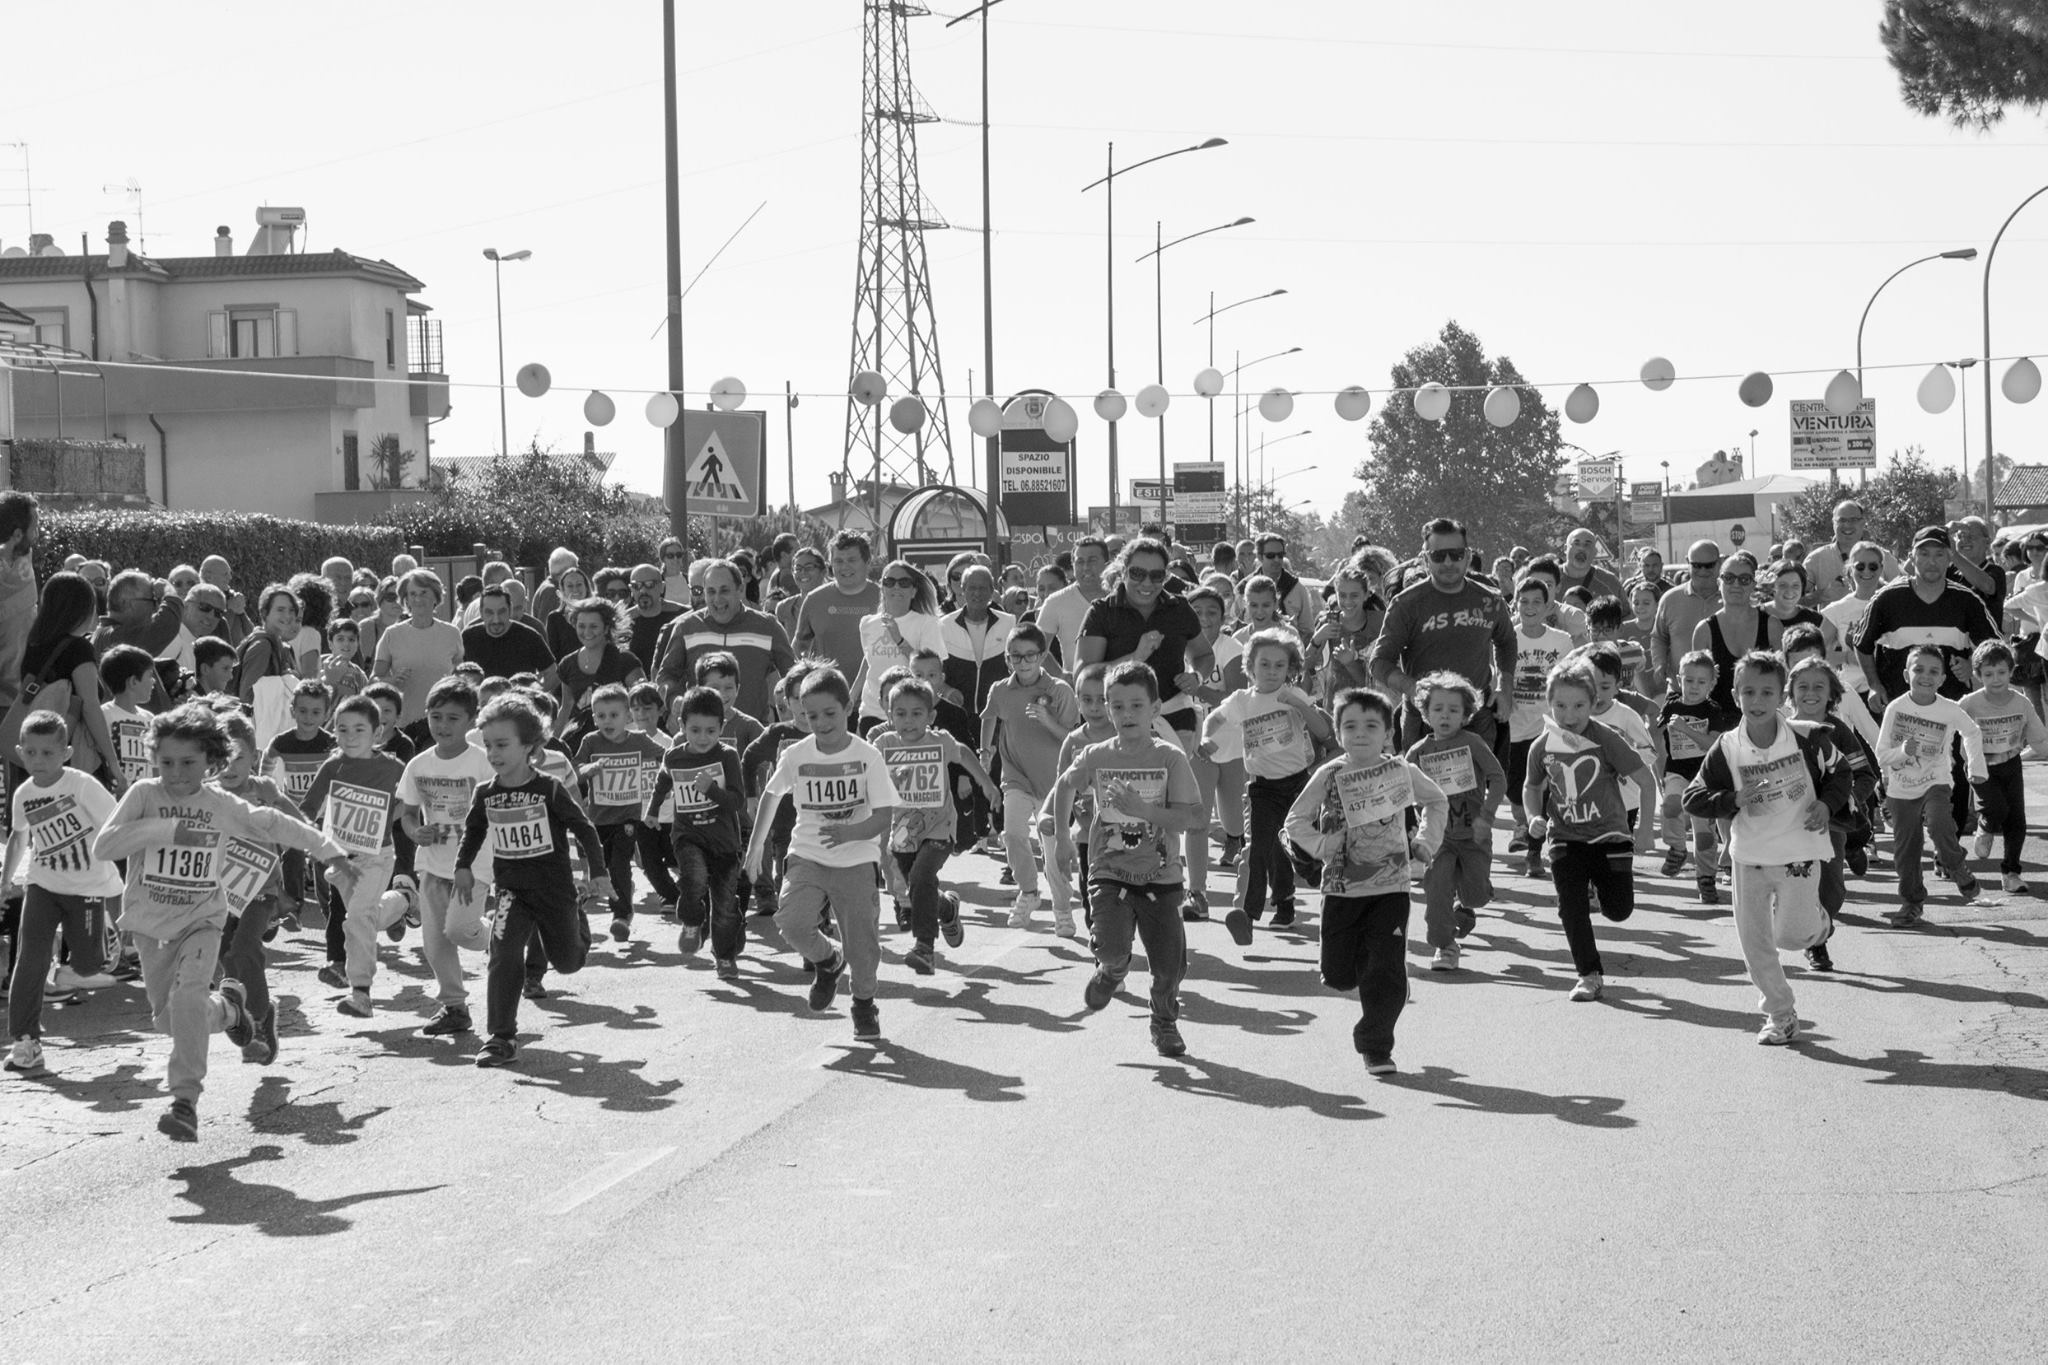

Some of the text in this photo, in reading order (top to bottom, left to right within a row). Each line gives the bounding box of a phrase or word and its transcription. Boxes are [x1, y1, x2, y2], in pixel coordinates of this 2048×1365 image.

[1792, 402, 1830, 412] CENTR
[1793, 415, 1874, 430] VENTURA
[1018, 453, 1050, 462] SPAZIO
[1006, 466, 1062, 475] DISPONIBILE
[1580, 466, 1611, 474] BOSCH
[1003, 479, 1066, 491] TEL. 06.88521607
[1580, 475, 1612, 484] Service
[1731, 530, 1745, 540] STOP
[1422, 609, 1494, 632] AS Roma
[680, 785, 708, 804] 112
[806, 778, 858, 802] 11404
[484, 792, 508, 808] DEEP
[510, 791, 546, 804] SPACE
[1349, 799, 1366, 812] 437
[158, 806, 214, 824] DALLAS
[332, 801, 382, 836] 1706
[36, 813, 82, 847] 11129
[494, 822, 543, 849] 11464
[157, 847, 212, 879] 11368
